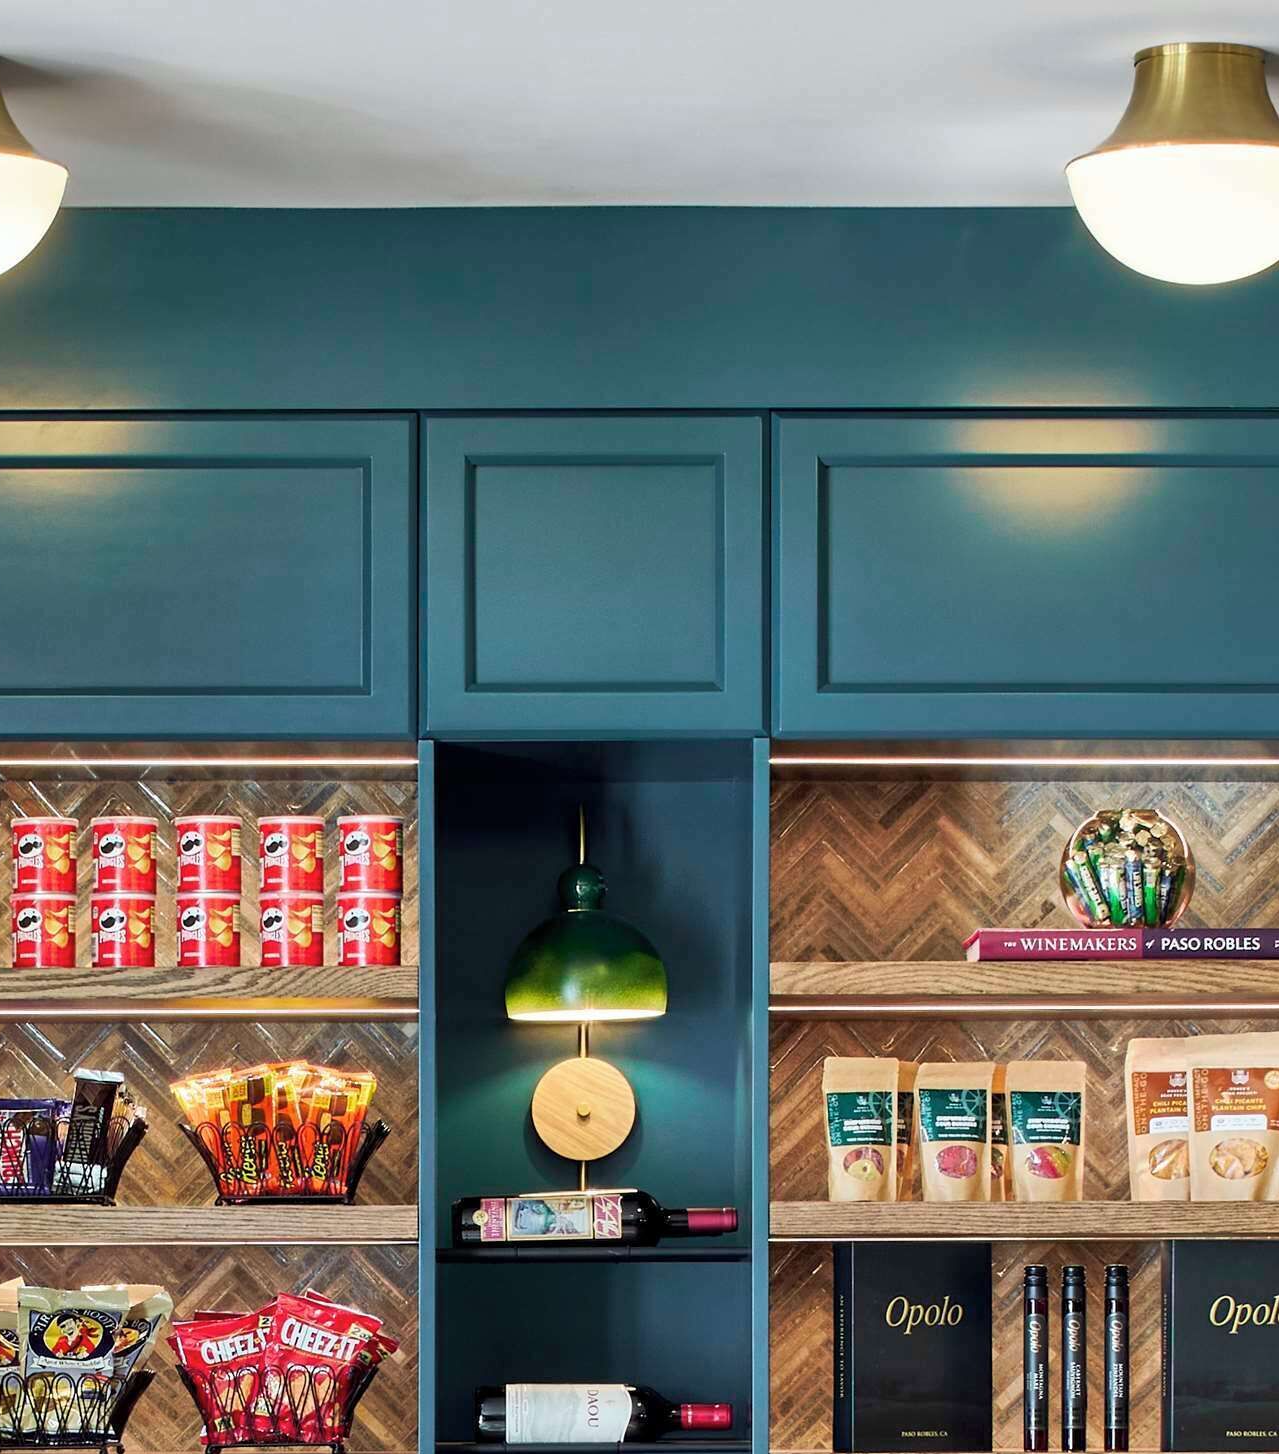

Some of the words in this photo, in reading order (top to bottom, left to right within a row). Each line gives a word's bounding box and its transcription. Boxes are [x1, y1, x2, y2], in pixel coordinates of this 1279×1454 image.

[1020, 938, 1137, 952] WINEMAKERS
[1161, 937, 1201, 951] PASO
[1203, 937, 1261, 951] ROBLES
[83, 1309, 117, 1331] BOOTY
[885, 1295, 964, 1335] Opolo
[1029, 1321, 1041, 1353] Opolo
[1067, 1319, 1080, 1352] Opolo
[1109, 1319, 1123, 1352] Opolo
[587, 1389, 599, 1428] DAOU
